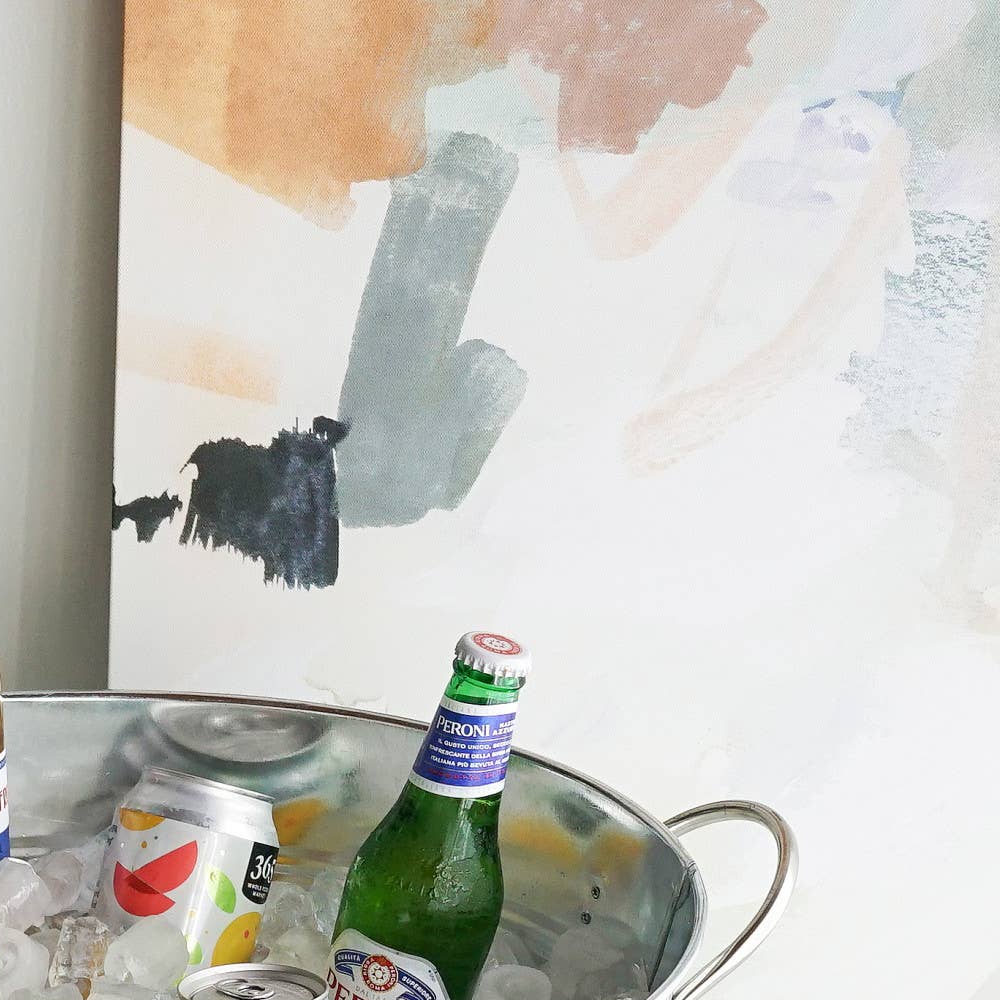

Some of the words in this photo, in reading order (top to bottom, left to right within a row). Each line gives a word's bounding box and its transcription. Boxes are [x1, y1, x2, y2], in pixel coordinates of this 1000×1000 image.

[436, 714, 490, 737] PERONI
[443, 740, 466, 749] GUSTO
[401, 975, 433, 1000] SUPERIORE
